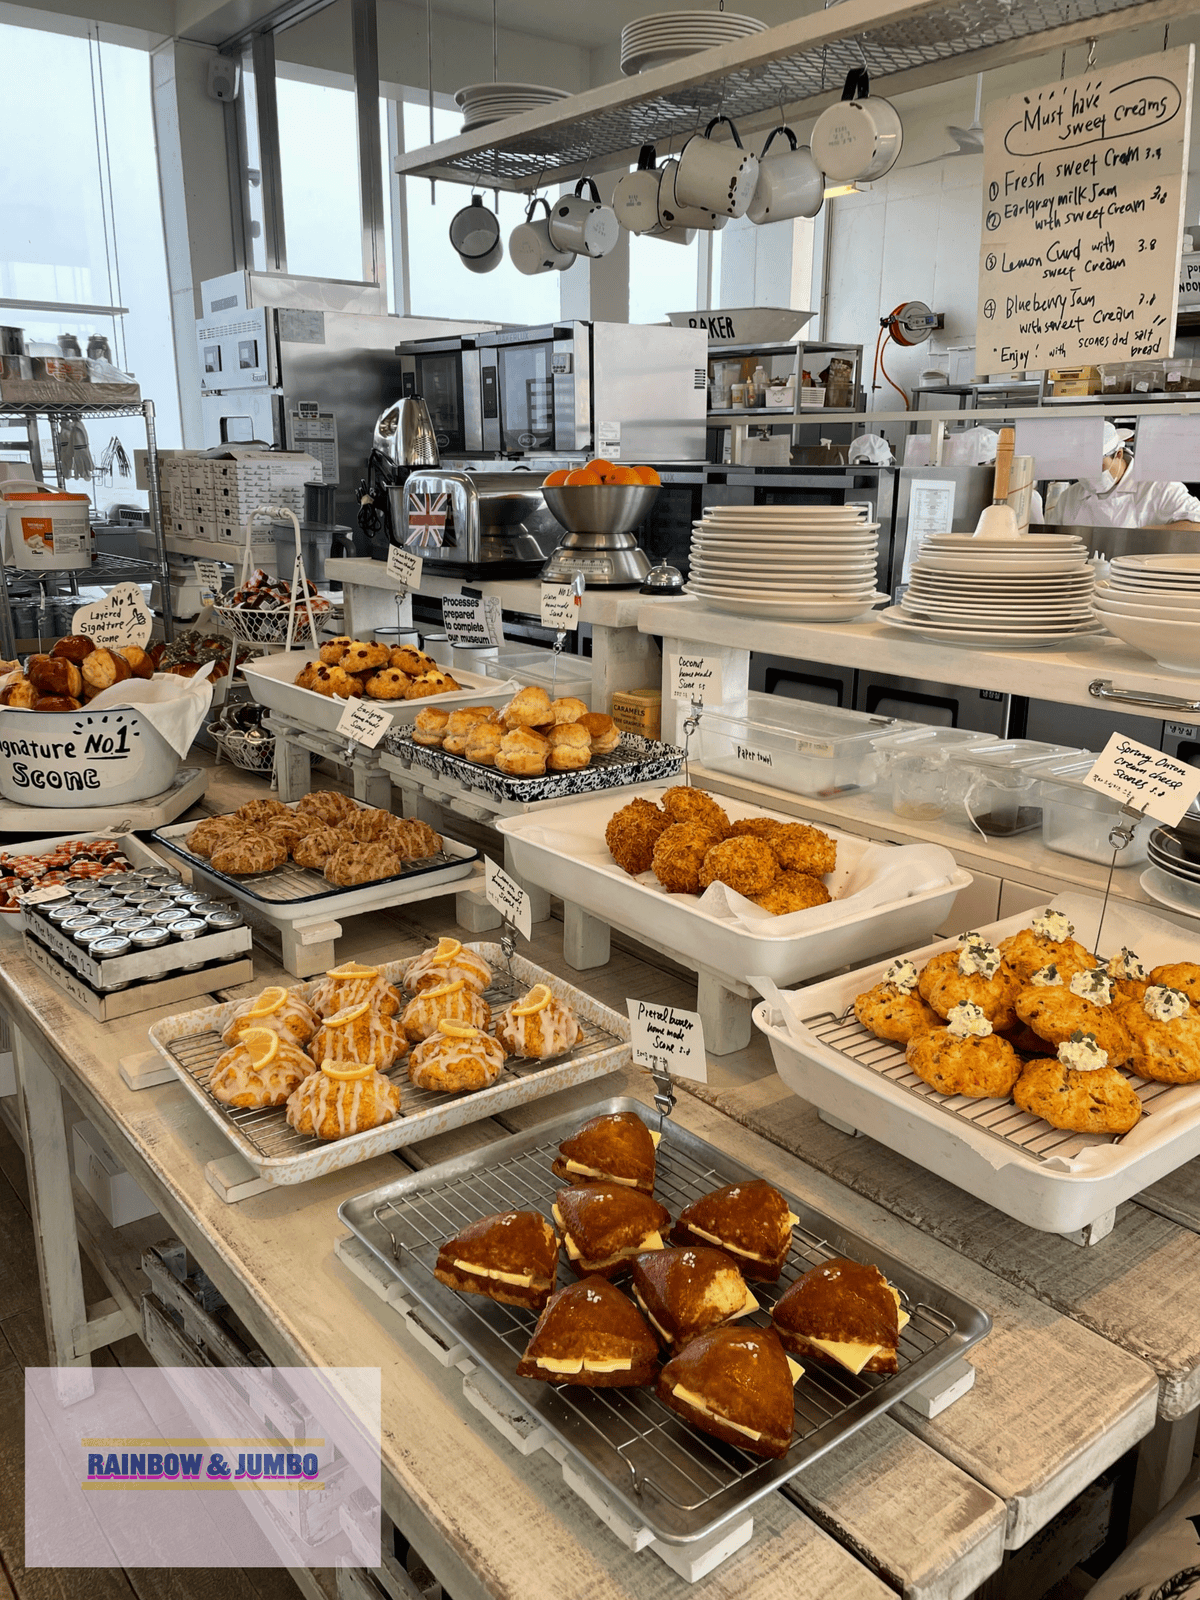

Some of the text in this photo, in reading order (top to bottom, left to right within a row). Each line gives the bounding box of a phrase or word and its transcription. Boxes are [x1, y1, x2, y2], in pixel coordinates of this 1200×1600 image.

[1024, 89, 1100, 132] Must have
[1058, 114, 1107, 140] sweet
[1005, 161, 1045, 196] Fresh
[1056, 152, 1098, 177] sweet
[1035, 210, 1061, 231] with
[1064, 206, 1105, 229] sweet
[1002, 252, 1043, 273] Lemon
[1091, 231, 1115, 253] with
[1138, 238, 1157, 253] 3.8
[1042, 266, 1076, 282] sweet
[1006, 292, 1067, 320] Blueberry
[1070, 287, 1095, 308] Jam
[1019, 318, 1042, 334] with
[1044, 315, 1085, 334] sweet
[1049, 342, 1066, 358] with
[1078, 336, 1110, 348] scones
[1112, 331, 1129, 346] and
[1134, 328, 1153, 341] salt
[1131, 337, 1162, 357] bread
[442, 596, 480, 608] Processes
[90, 607, 122, 621] Layered
[443, 609, 475, 621] prepared
[80, 621, 125, 636] Signature
[445, 620, 485, 634] to complete
[447, 633, 490, 645] our museum
[678, 656, 704, 669] Coconut
[613, 704, 646, 717] CARAMELS
[1169, 725, 1193, 736] 냉장실
[1115, 741, 1187, 776] Spring Onion
[12, 762, 101, 791] Scone
